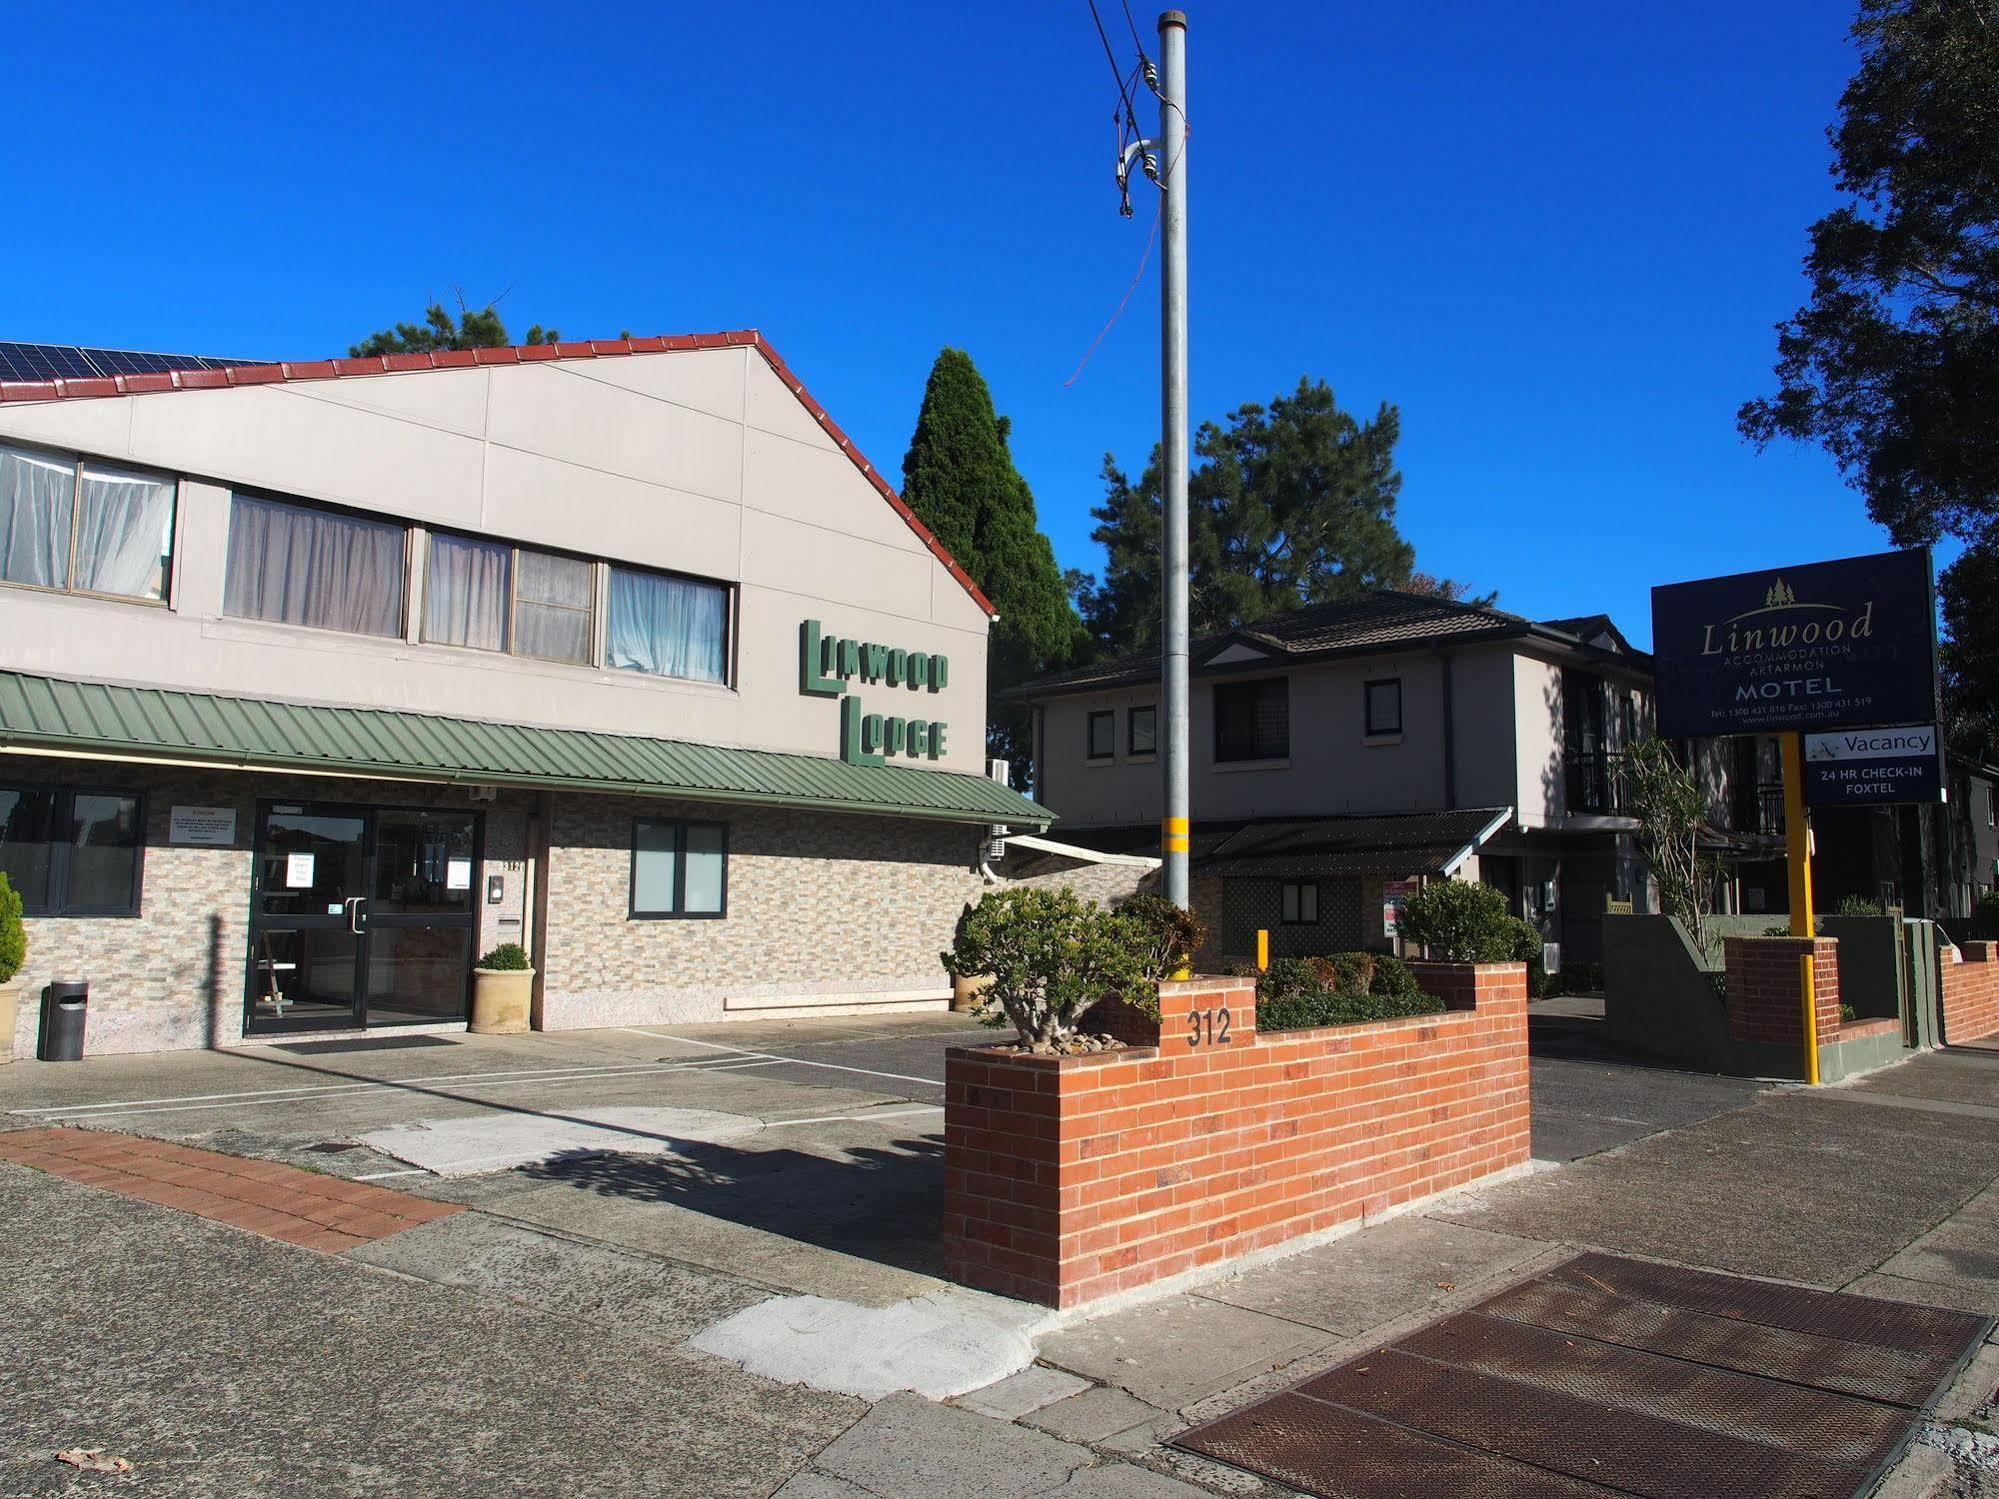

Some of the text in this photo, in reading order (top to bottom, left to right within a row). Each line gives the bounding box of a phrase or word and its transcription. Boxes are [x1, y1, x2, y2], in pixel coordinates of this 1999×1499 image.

[1700, 601, 1873, 656] Linwood
[799, 619, 949, 699] LINWOOD
[1724, 643, 1851, 666] ACCOMMODATION
[1749, 660, 1825, 677] ARTARMON
[1735, 677, 1842, 701] MOTEL
[1728, 707, 1749, 717] 1300
[1751, 706, 1766, 715] 431
[1769, 704, 1785, 713] 816
[1811, 699, 1832, 710] 1300
[1854, 696, 1872, 706] 519
[1741, 710, 1840, 725] www.linwood.com.au
[840, 695, 948, 767] LODGE
[1844, 735, 1931, 753] Vacancy
[1821, 766, 1923, 781] 24 HR CHECK-IN
[1846, 783, 1896, 795] FOXTEL
[503, 861, 521, 872] 312
[1187, 1007, 1231, 1047] 312
